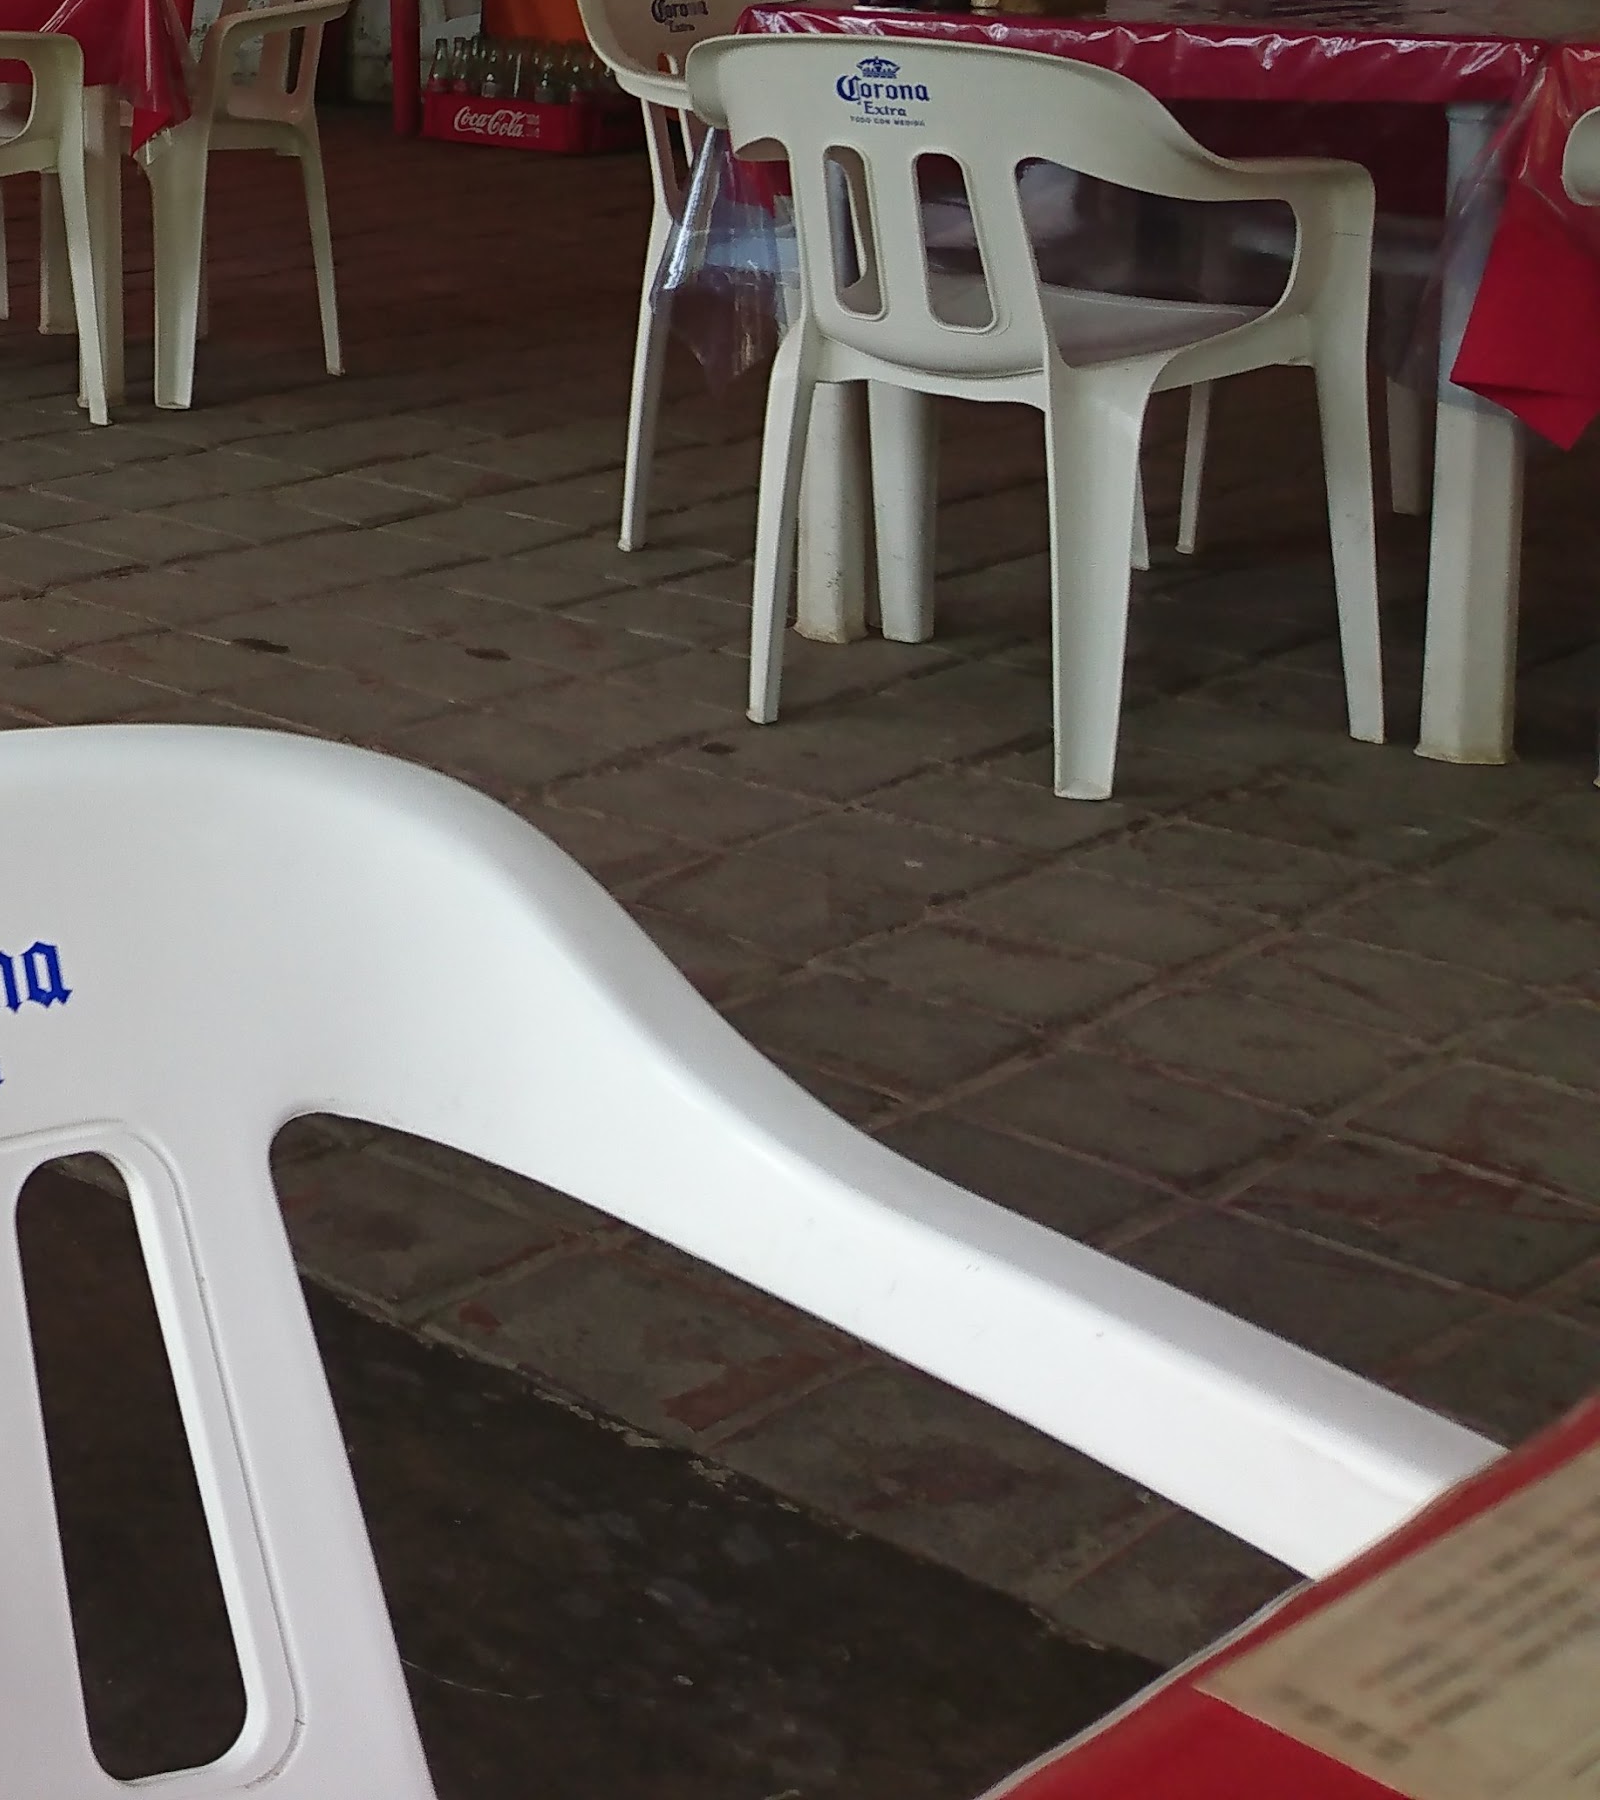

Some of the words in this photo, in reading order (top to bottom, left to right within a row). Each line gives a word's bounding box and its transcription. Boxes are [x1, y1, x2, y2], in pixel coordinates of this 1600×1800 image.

[836, 75, 931, 102] Corona
[454, 105, 526, 138] Coca-Cola
[863, 101, 908, 117] Extra
